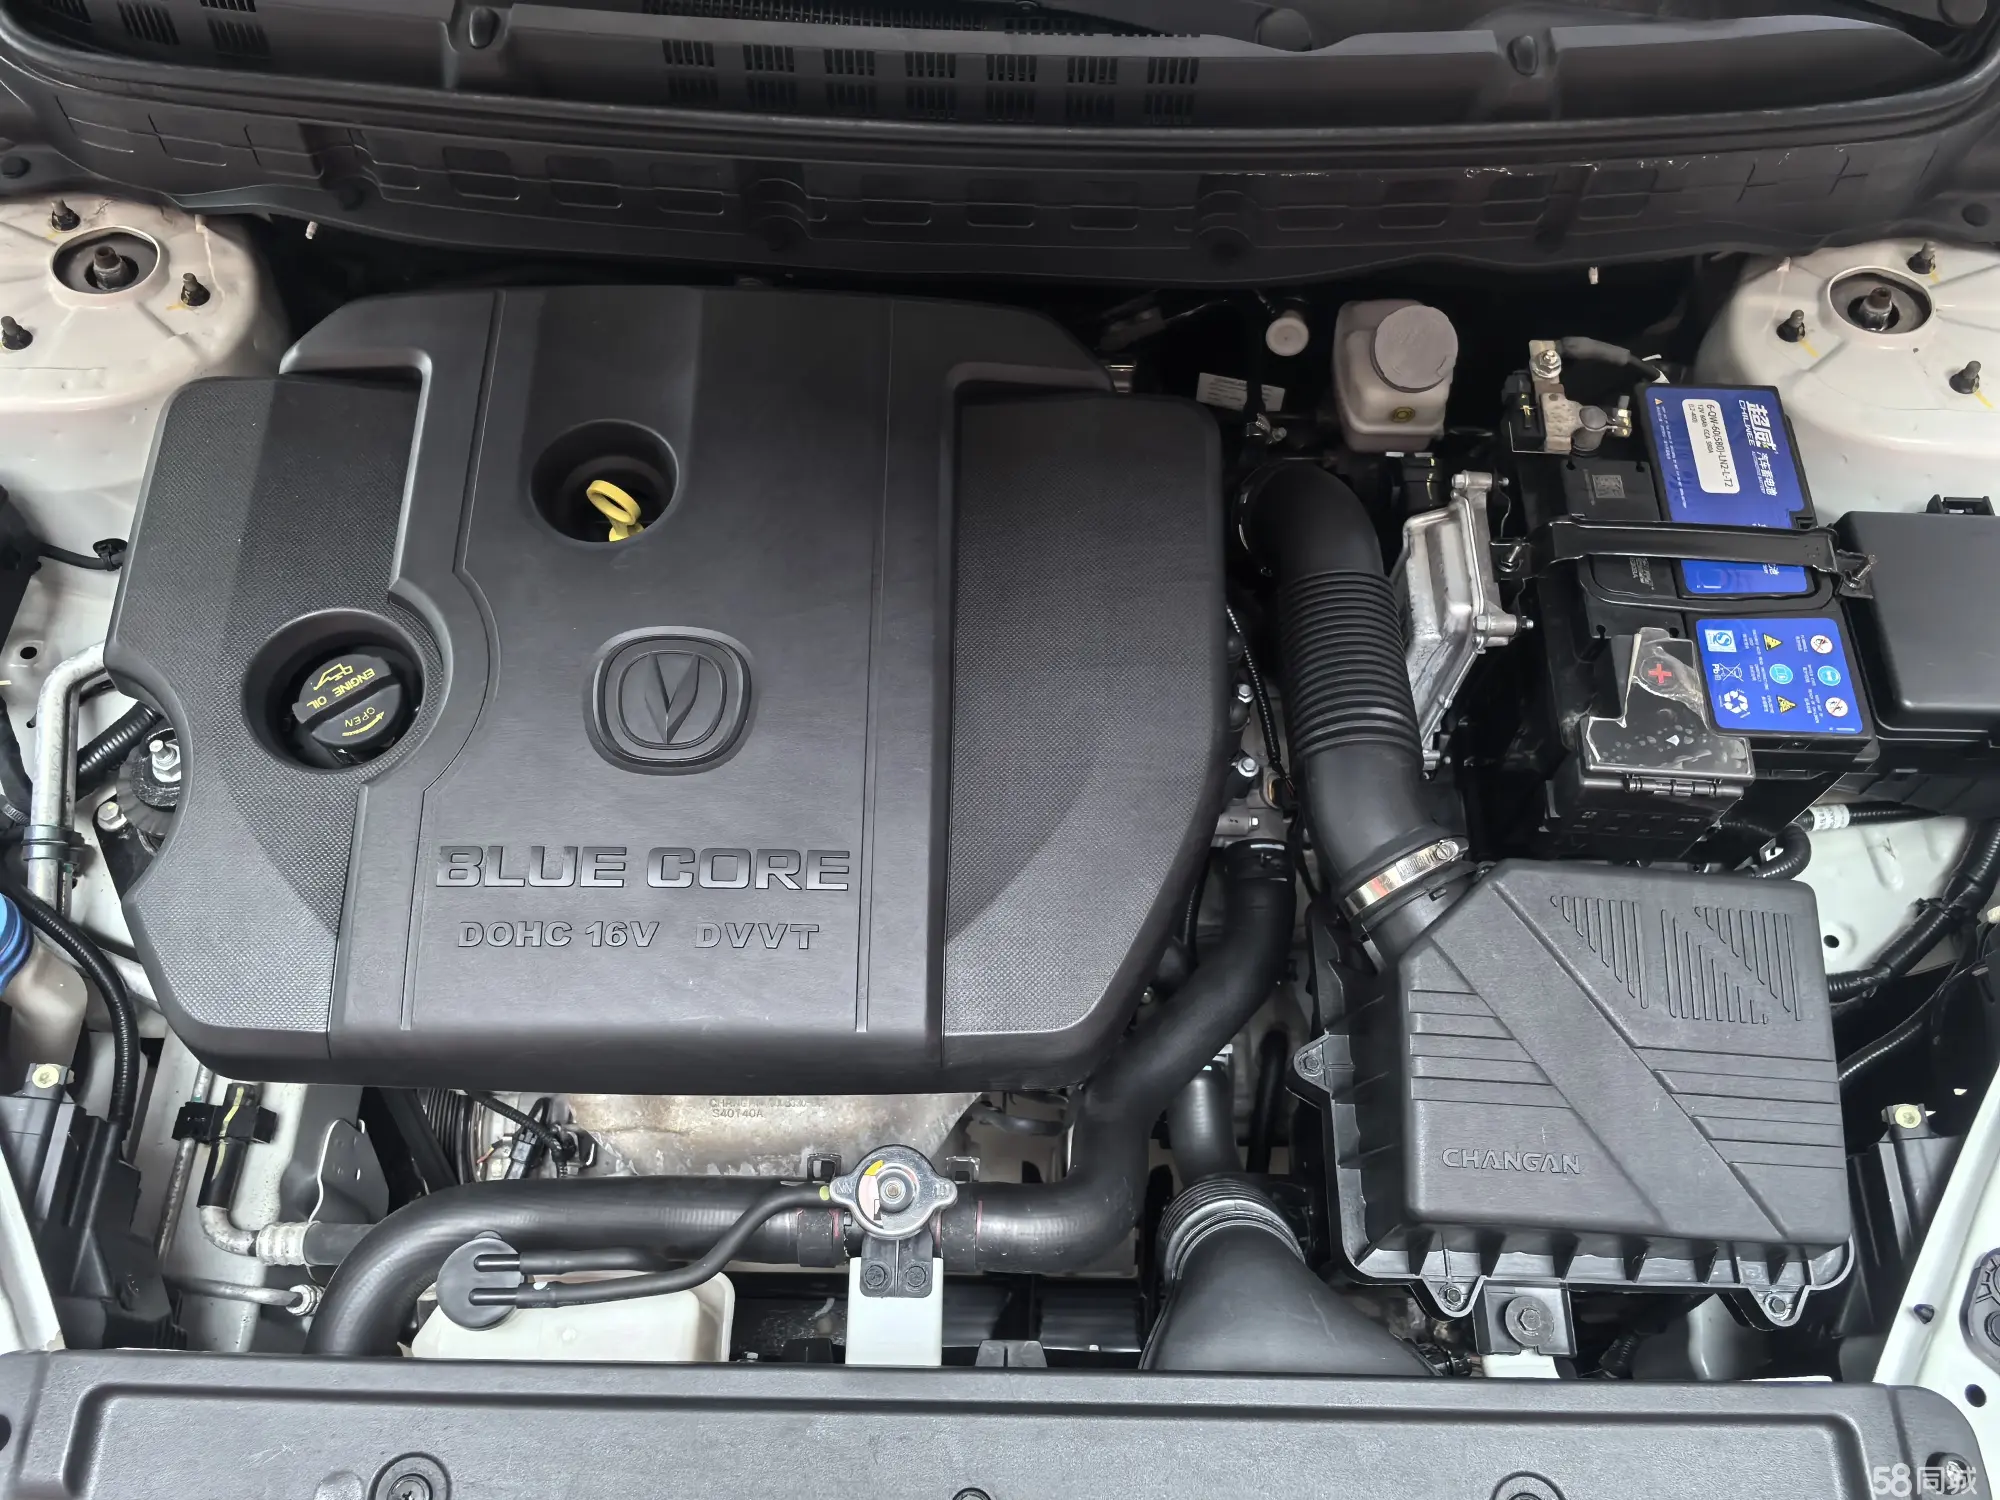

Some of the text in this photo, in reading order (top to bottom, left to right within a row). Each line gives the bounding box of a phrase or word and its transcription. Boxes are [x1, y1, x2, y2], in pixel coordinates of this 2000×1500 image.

[1739, 400, 1755, 446] CHILWEE
[307, 667, 375, 709] ENGINE OIL
[345, 707, 375, 727] OPEN
[436, 845, 851, 891] BLUE CORE
[457, 920, 820, 950] DOHC 16V DVVT
[1441, 1147, 1581, 1175] CHANGAN
